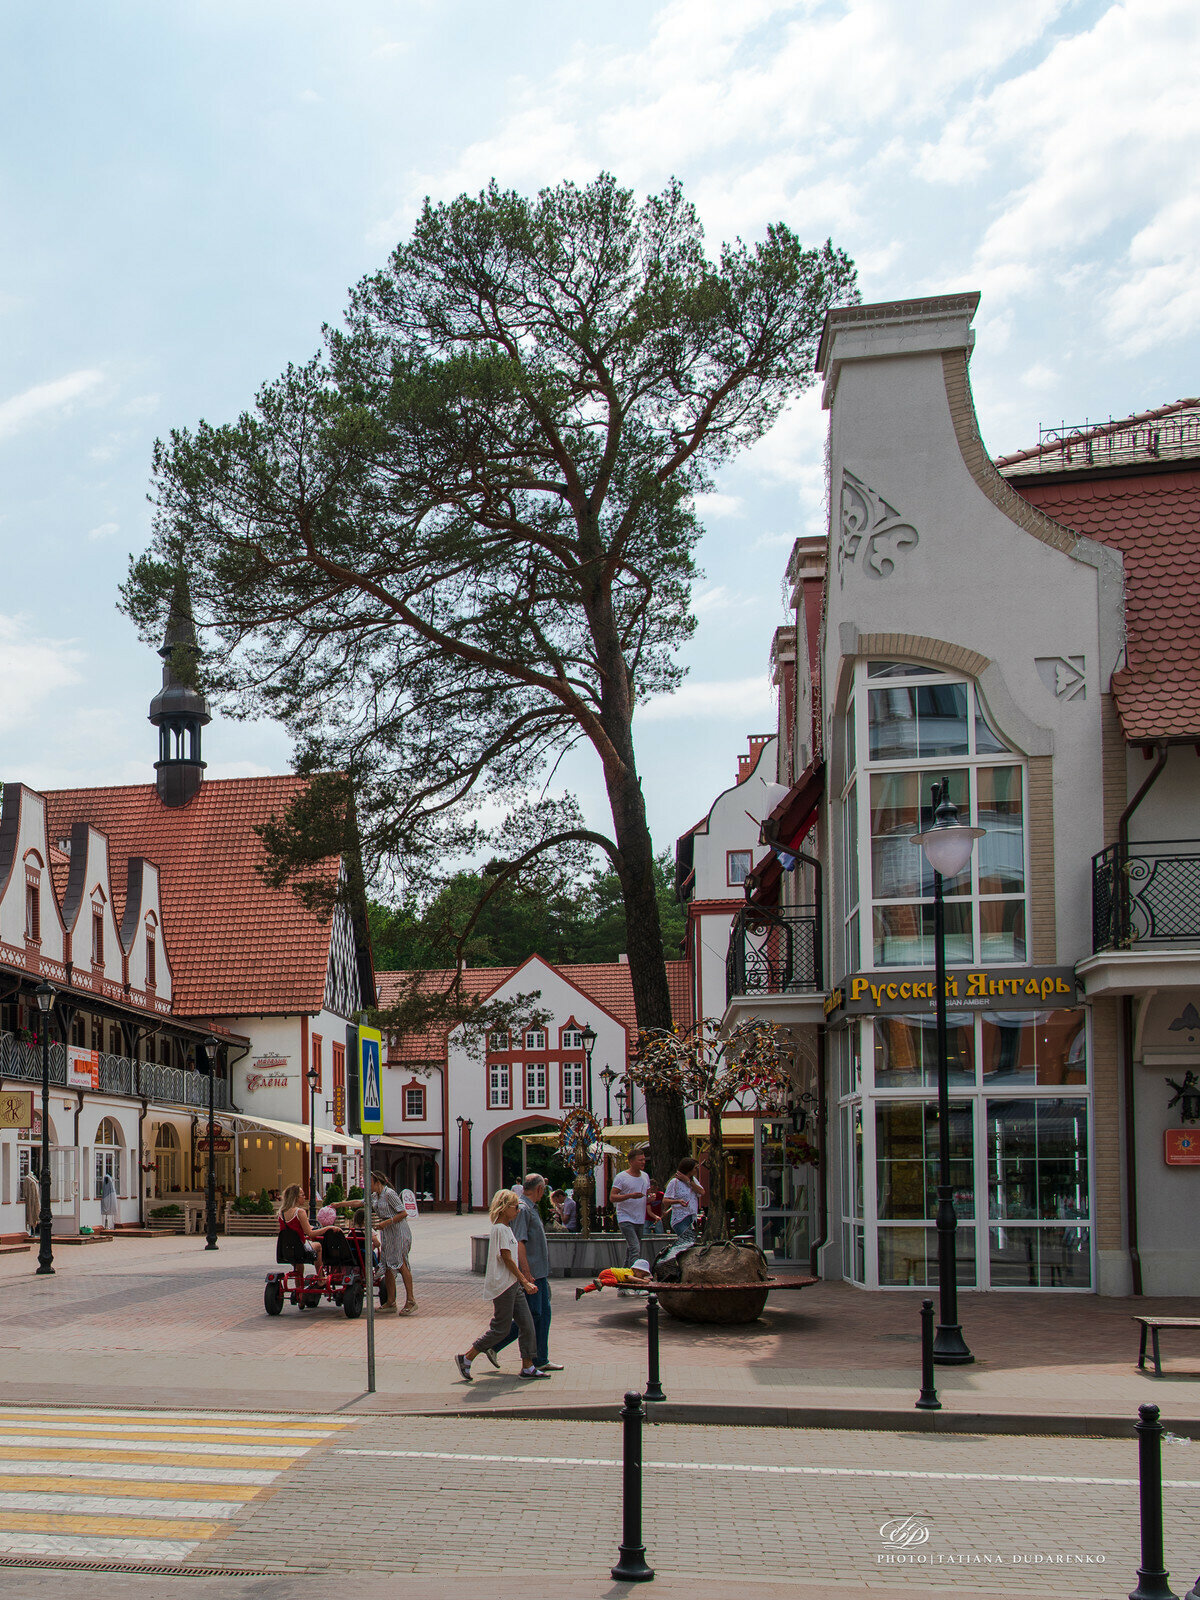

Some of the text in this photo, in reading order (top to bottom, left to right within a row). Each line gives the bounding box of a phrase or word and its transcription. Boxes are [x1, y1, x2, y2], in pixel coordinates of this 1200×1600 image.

[850, 974, 958, 1007] Русский
[966, 973, 1071, 1000] Янтарь
[929, 998, 990, 1007] RSIAN AMBER
[246, 1074, 288, 1092] Елена
